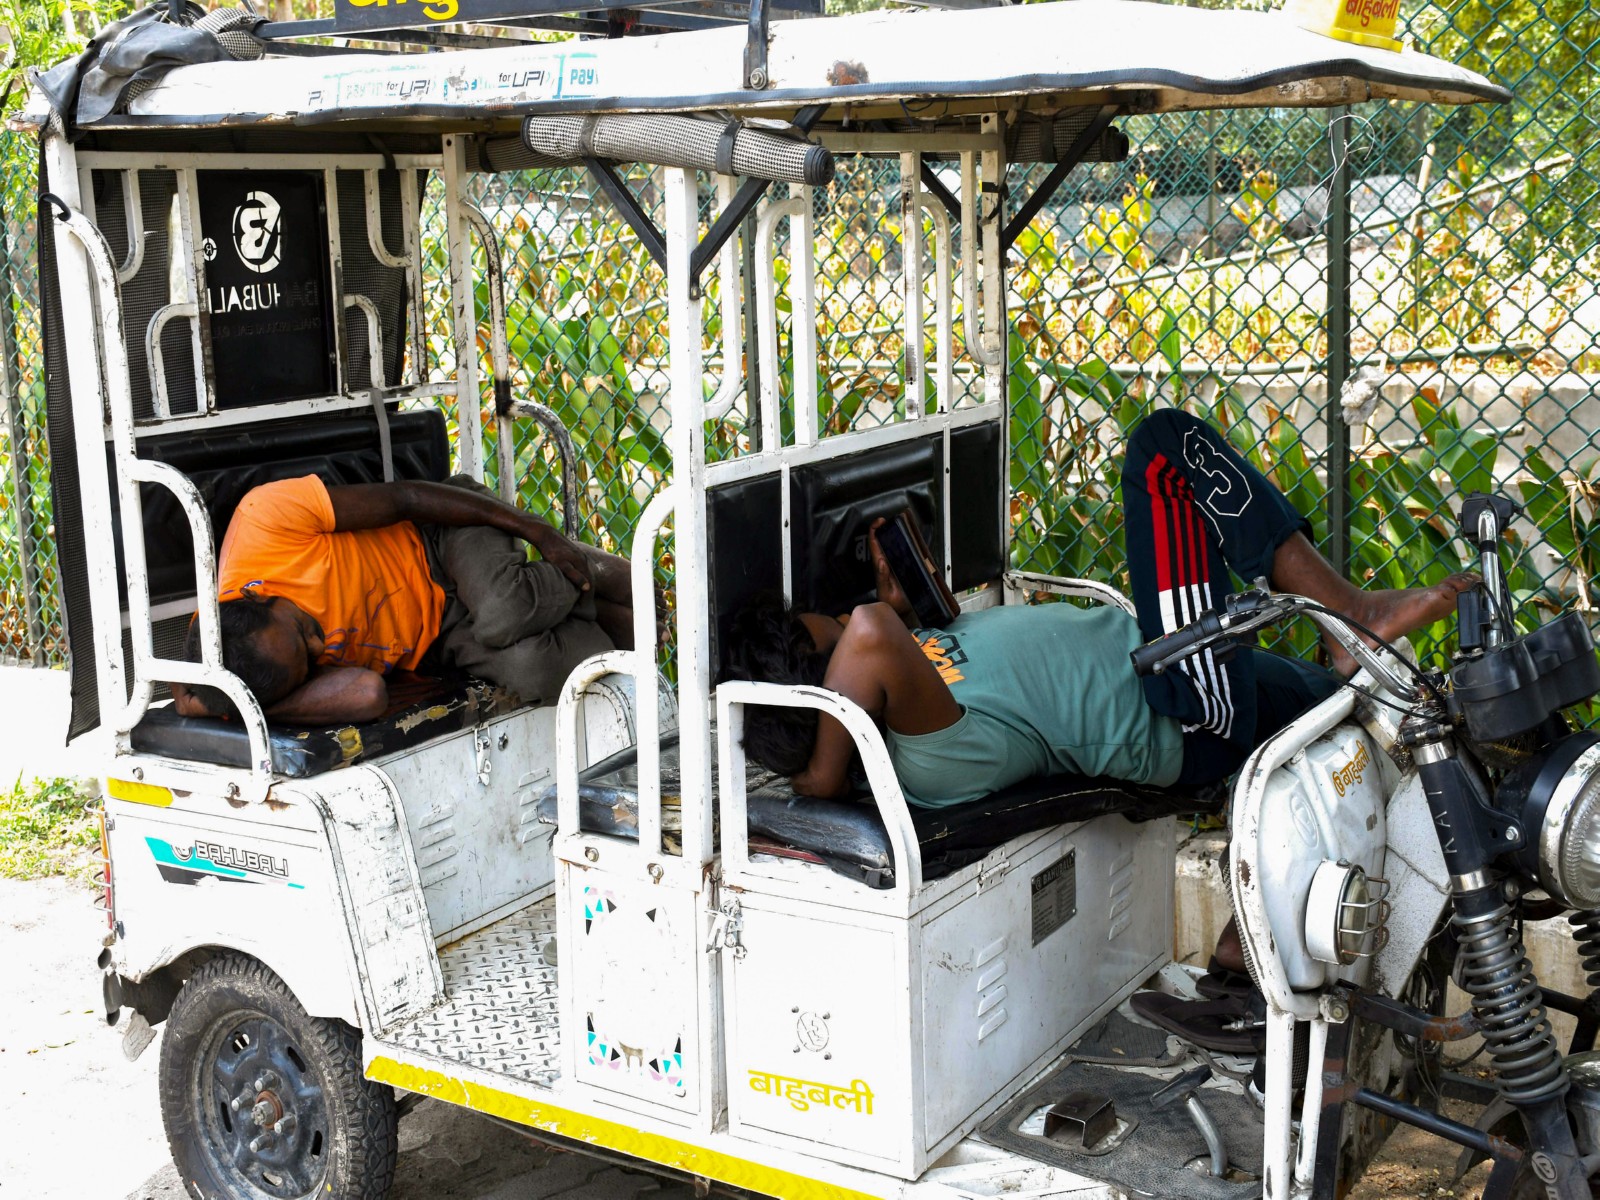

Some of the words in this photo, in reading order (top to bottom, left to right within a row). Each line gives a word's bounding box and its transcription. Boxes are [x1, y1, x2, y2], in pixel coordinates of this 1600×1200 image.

[399, 79, 431, 96] UPI
[498, 72, 512, 82] for
[512, 70, 545, 88] UPI
[194, 839, 289, 877] BAHUBALI
[748, 1069, 875, 1116] बाहुबली
